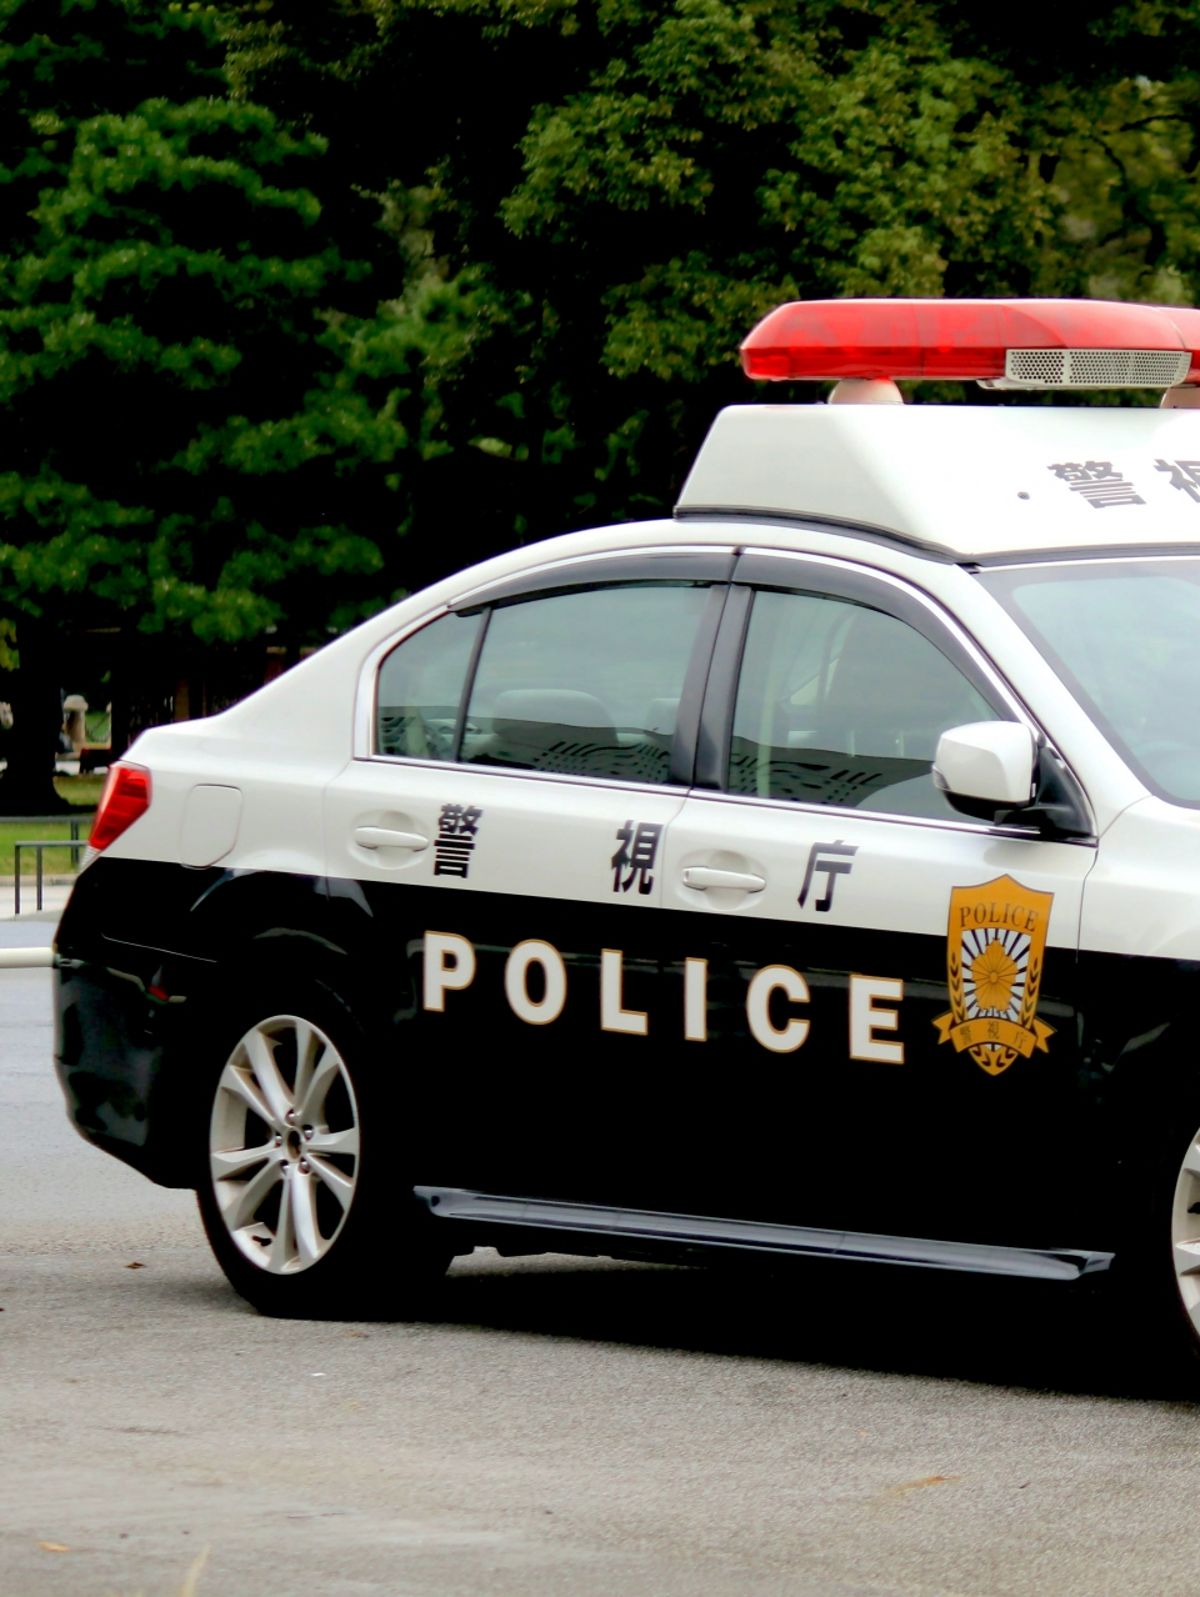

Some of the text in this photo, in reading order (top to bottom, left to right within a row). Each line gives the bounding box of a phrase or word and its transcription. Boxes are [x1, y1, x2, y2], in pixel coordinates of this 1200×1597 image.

[433, 803, 859, 912] 警視庁
[960, 902, 1038, 931] POLICE
[423, 930, 904, 1064] POLICE
